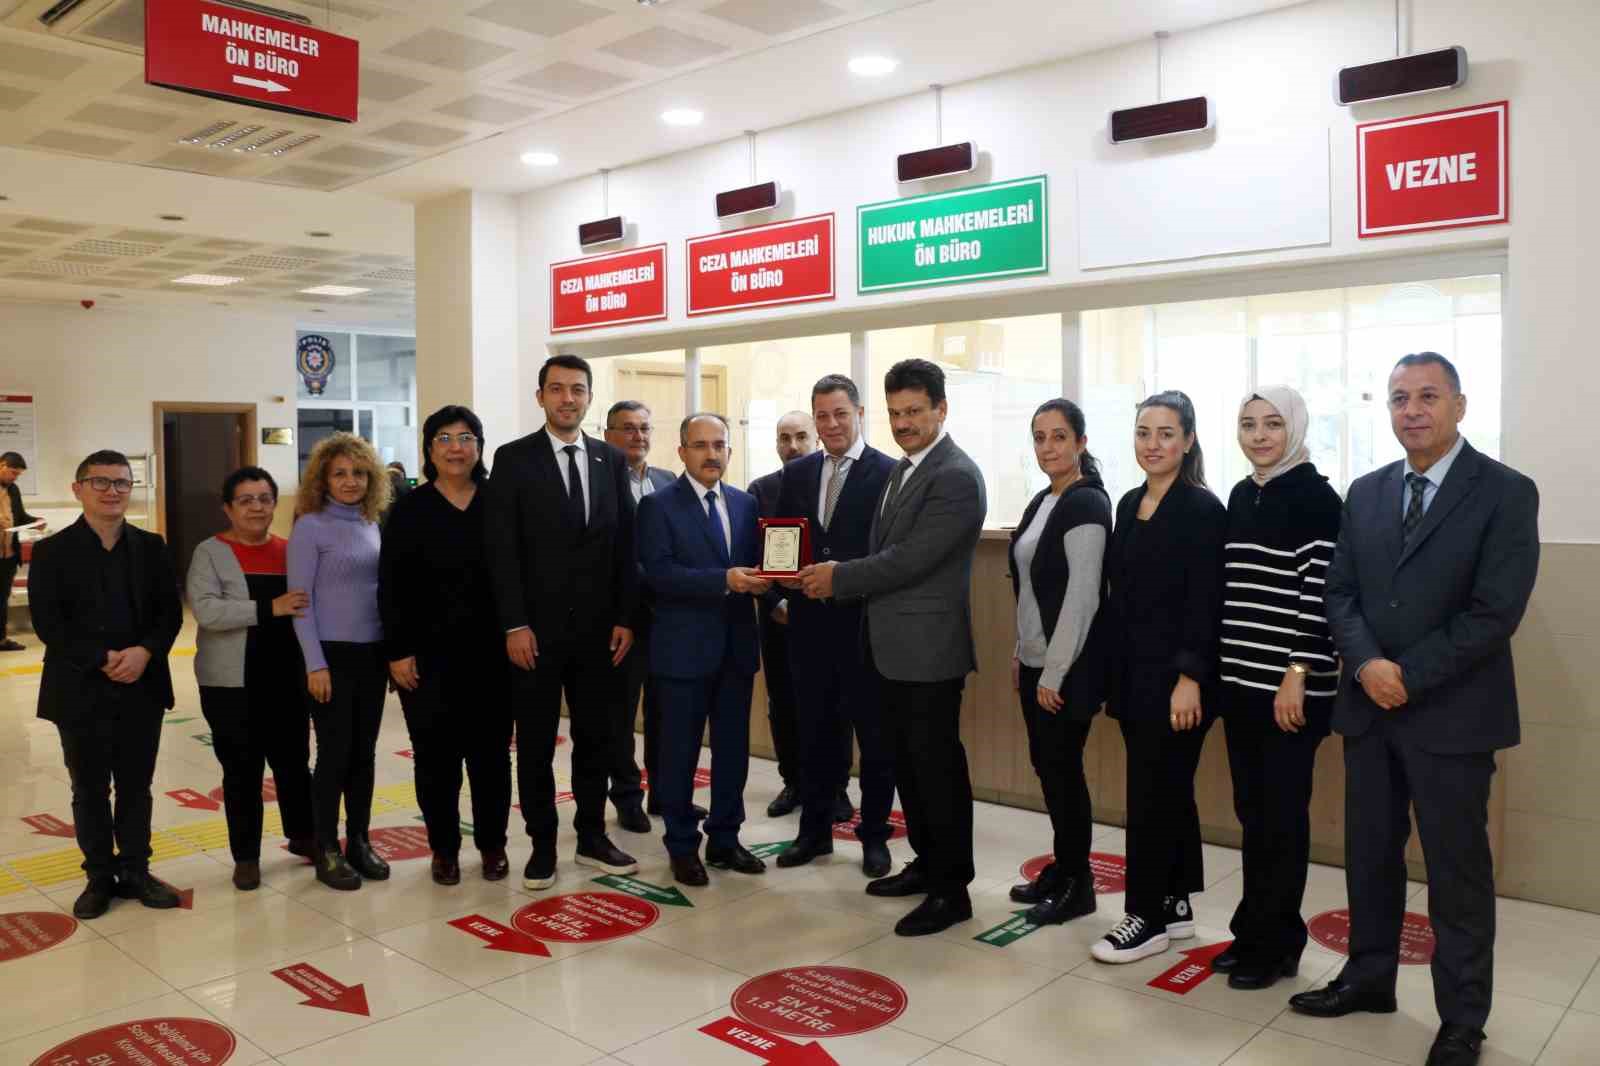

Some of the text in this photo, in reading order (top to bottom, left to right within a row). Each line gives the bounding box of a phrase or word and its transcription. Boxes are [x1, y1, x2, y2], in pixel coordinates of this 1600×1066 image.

[201, 13, 319, 57] MAHKEMELER
[225, 41, 299, 78] ÖN BÜRO
[1384, 152, 1477, 191] VEZNE
[867, 199, 1034, 245] HUKUK MAHKEMELERİ
[699, 235, 819, 274] CEZA MAHKEMELERİ
[914, 239, 981, 267] ÖN BÜRO
[560, 262, 655, 295] CEZA MAHKEMELERİ
[730, 269, 783, 293] ÖN BÜRO
[585, 291, 627, 313] ÖN BÜRO
[746, 996, 836, 1032] 1.5 METRE
[778, 995, 833, 1017] EN AZ
[726, 1026, 776, 1051] VEZNE
